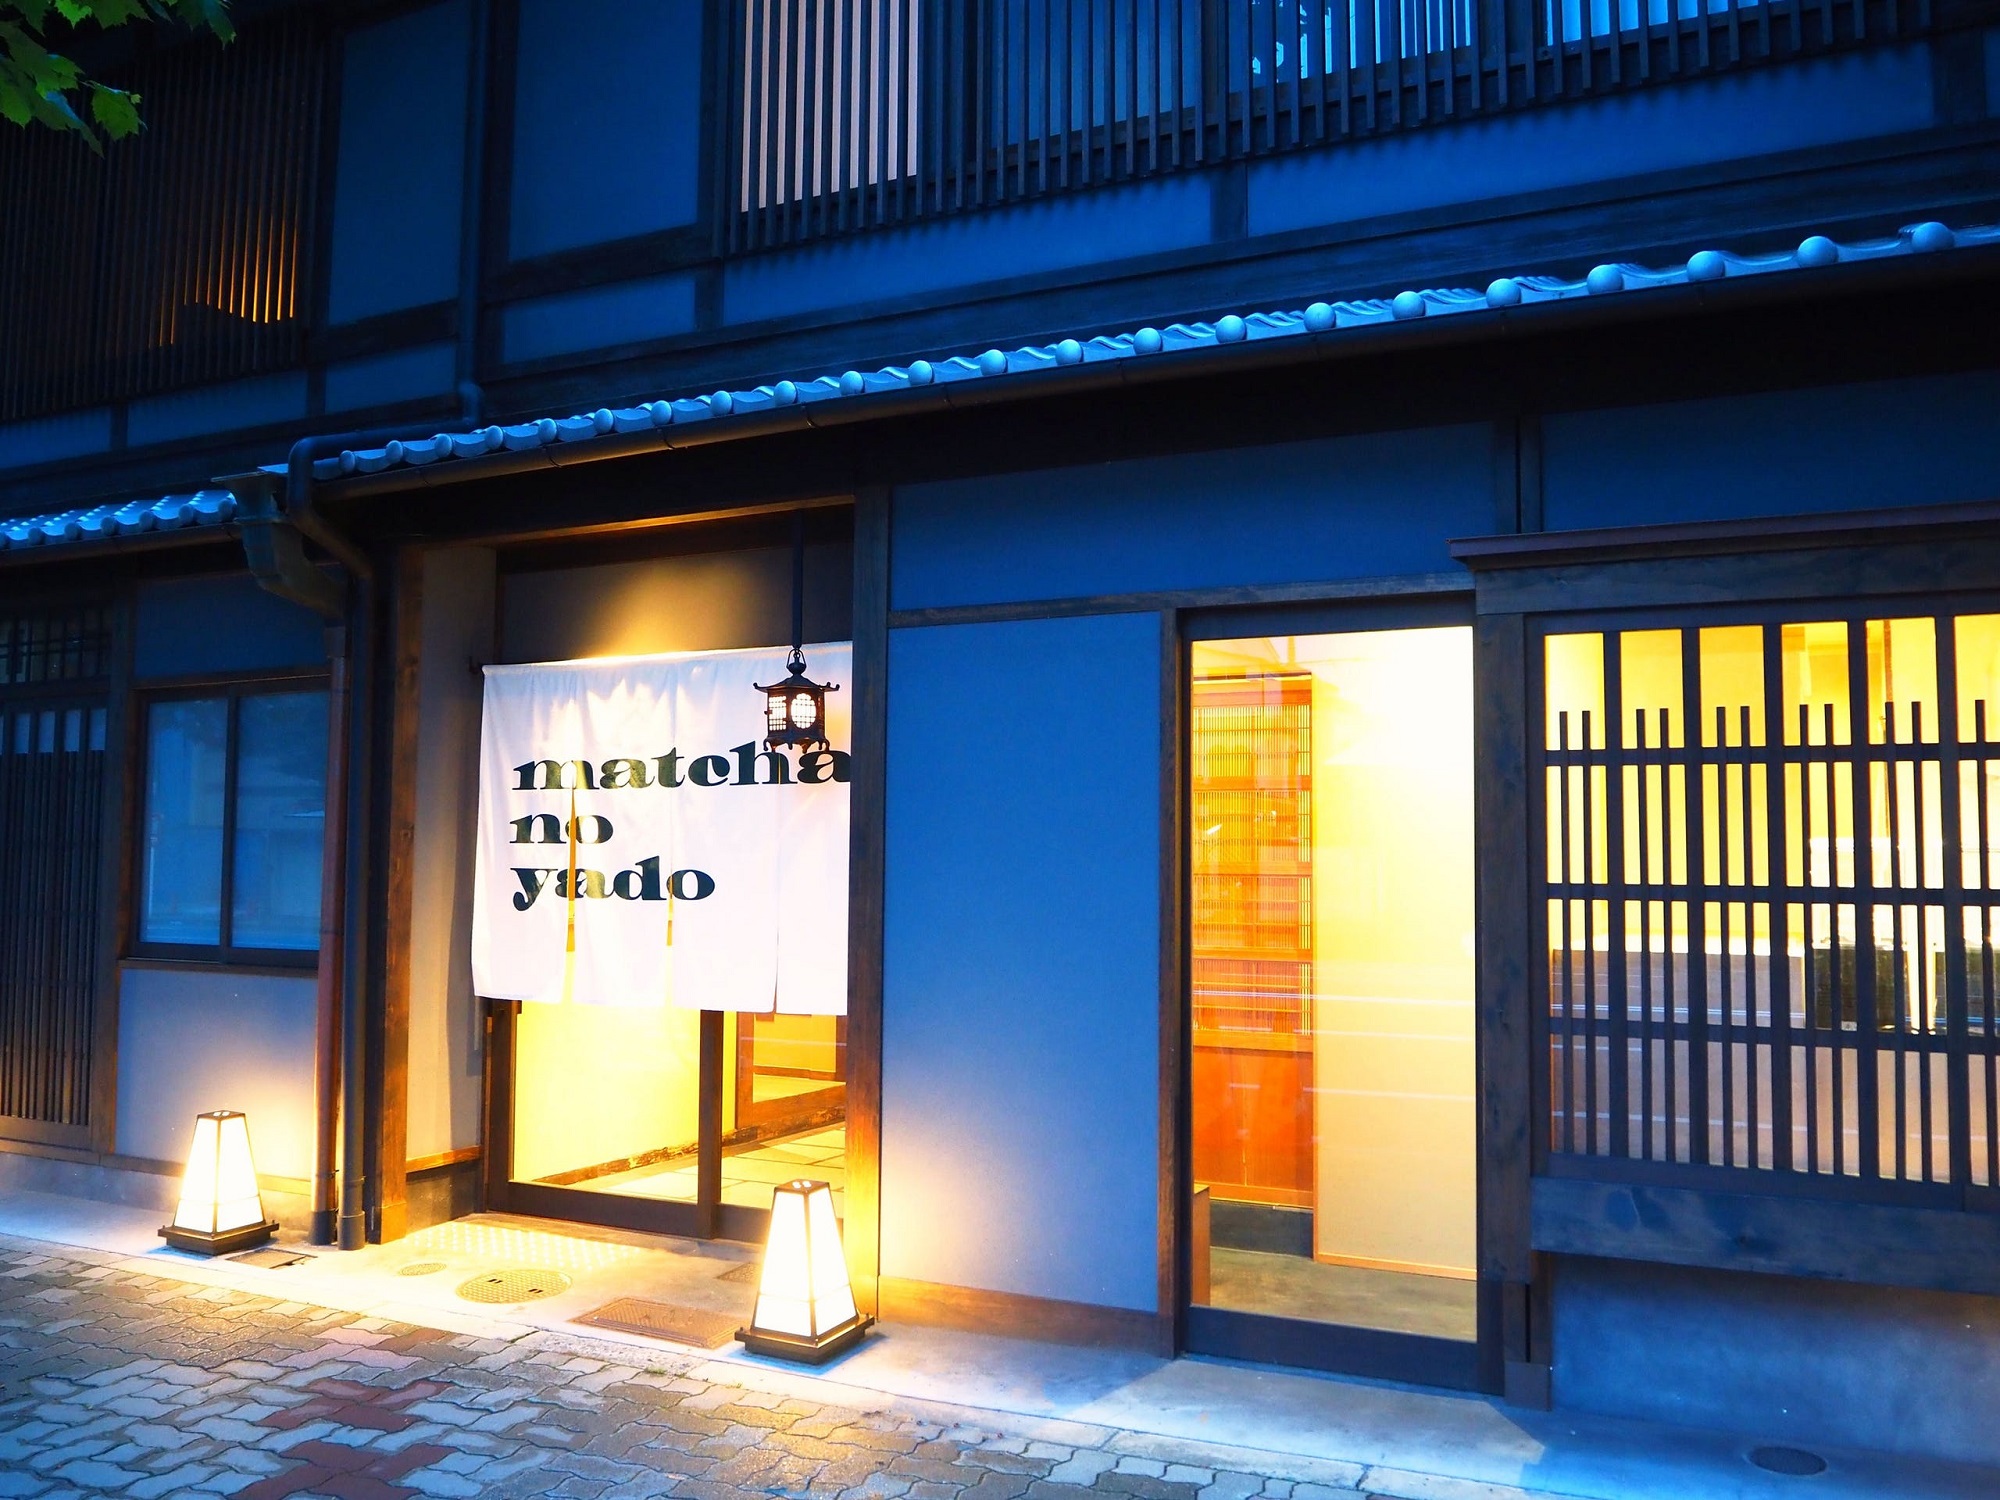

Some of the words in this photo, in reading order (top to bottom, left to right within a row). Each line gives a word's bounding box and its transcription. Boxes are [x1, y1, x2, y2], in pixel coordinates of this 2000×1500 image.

[512, 740, 851, 790] matcha
[509, 813, 614, 844] no
[510, 856, 716, 912] yado
